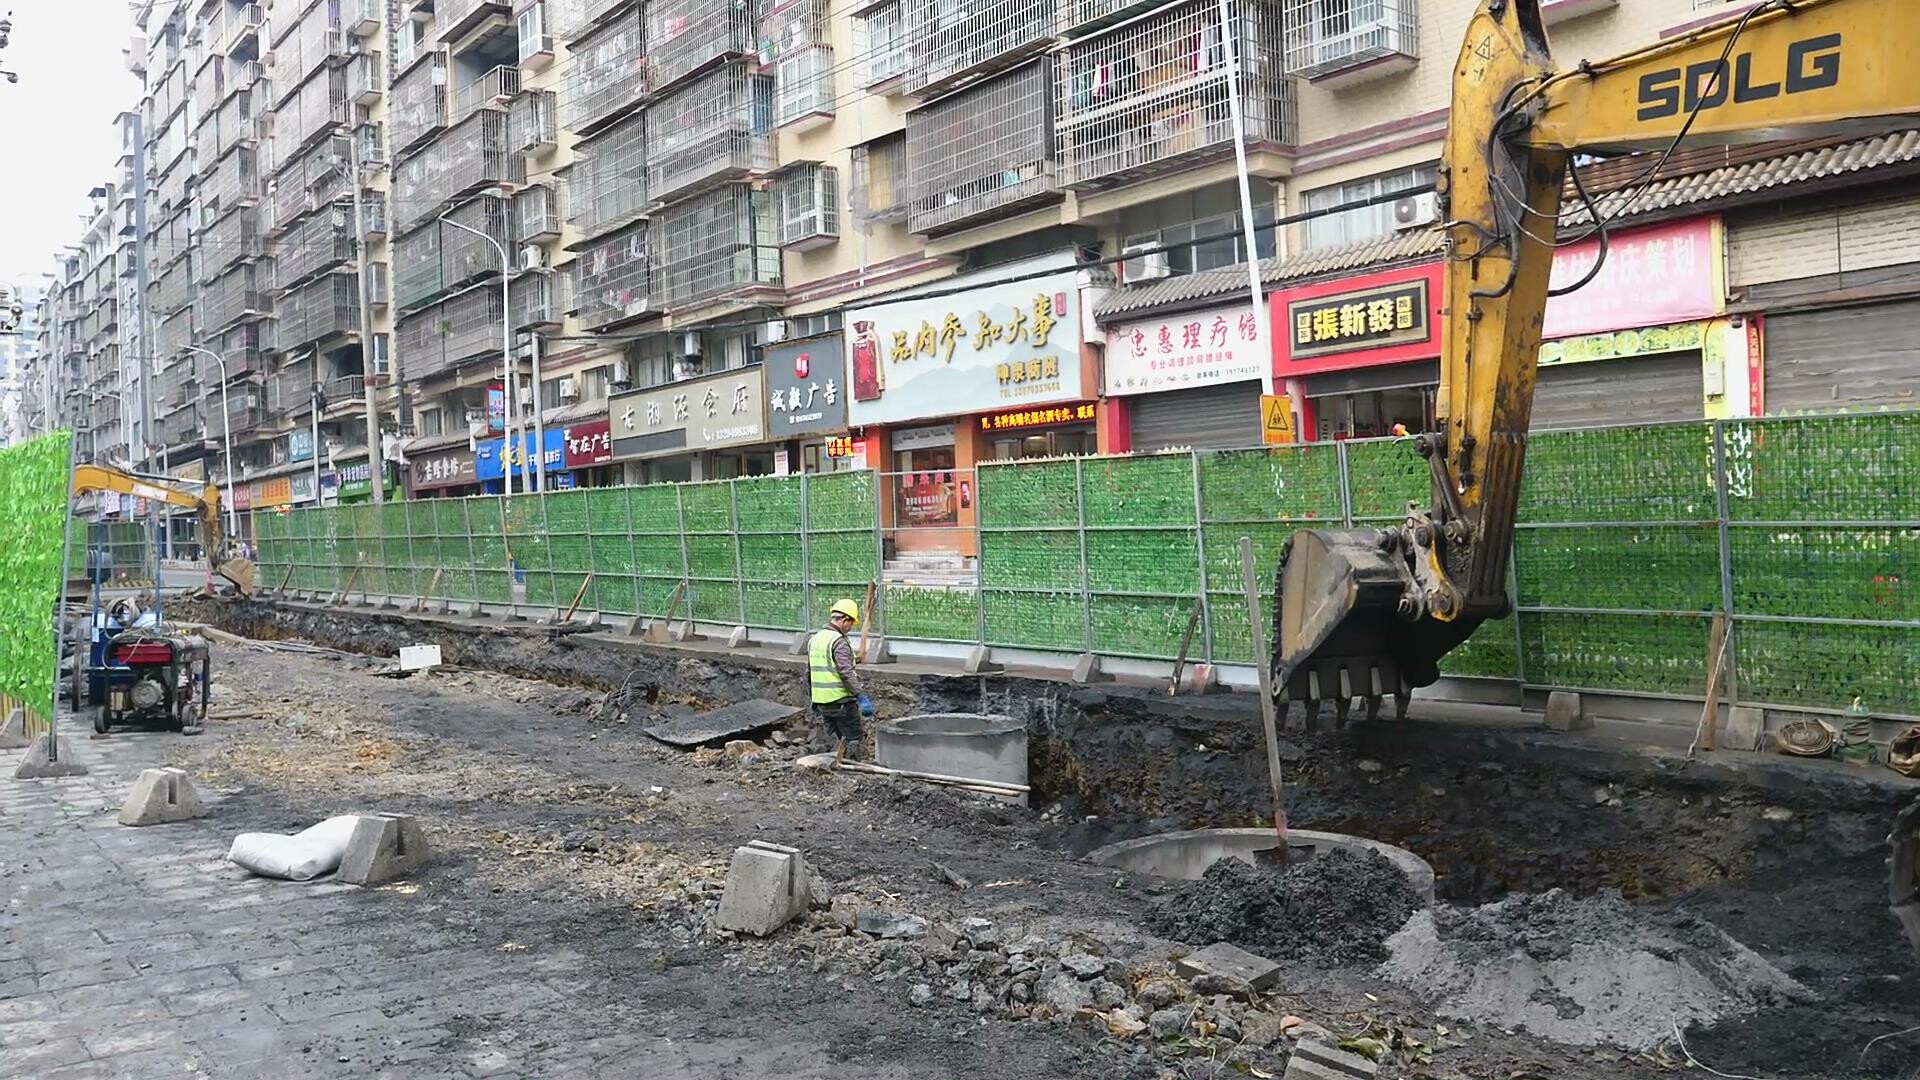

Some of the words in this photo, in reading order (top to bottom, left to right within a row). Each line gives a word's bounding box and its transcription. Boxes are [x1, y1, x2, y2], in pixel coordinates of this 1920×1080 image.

[1637, 33, 1842, 122] SDLG
[1131, 312, 1258, 359] 忠惠理疗馆
